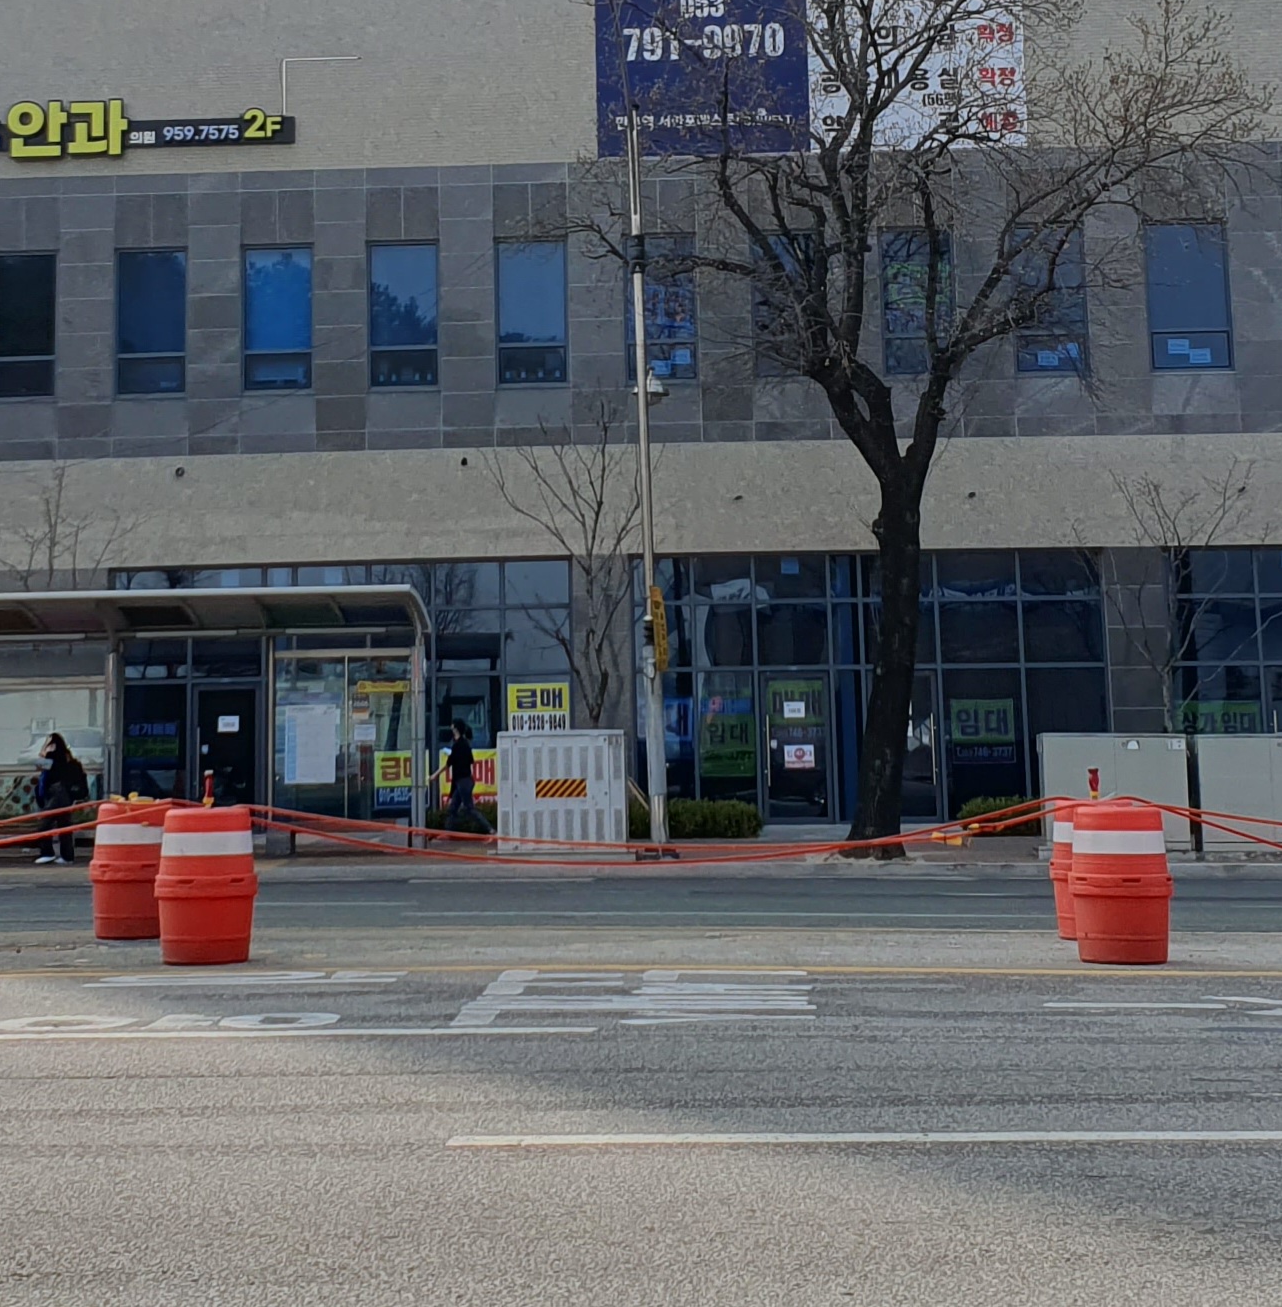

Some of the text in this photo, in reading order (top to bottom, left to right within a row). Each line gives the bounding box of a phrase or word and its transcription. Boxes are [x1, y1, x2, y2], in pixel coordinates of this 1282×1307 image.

[623, 23, 785, 62] 791-9970
[977, 23, 1014, 44] 확정
[979, 67, 1016, 86] 확정
[129, 131, 156, 144] 의원
[163, 124, 239, 141] 959.7575
[244, 108, 282, 138] 2F
[516, 688, 563, 709] 급매
[955, 701, 1009, 736] 임대
